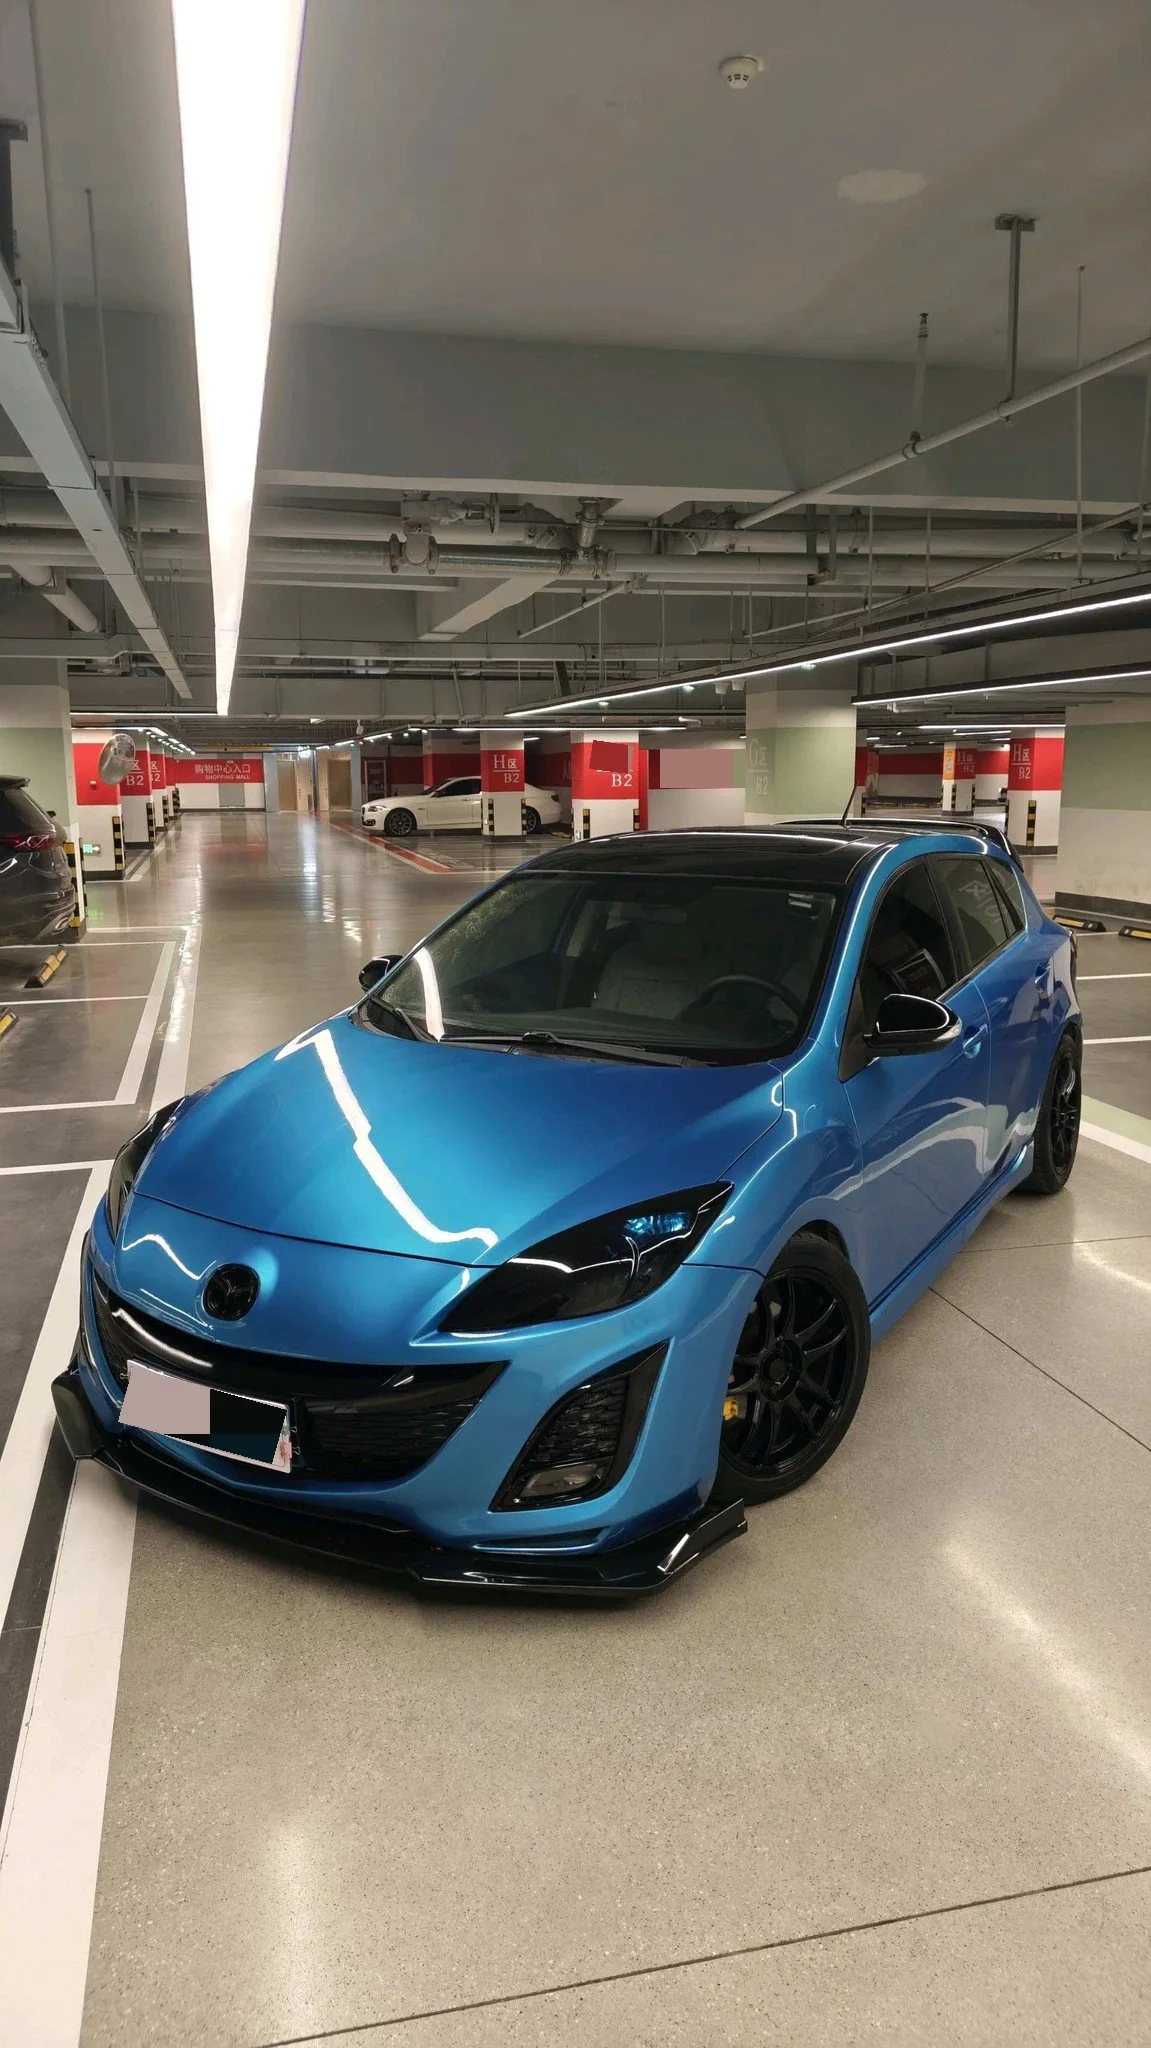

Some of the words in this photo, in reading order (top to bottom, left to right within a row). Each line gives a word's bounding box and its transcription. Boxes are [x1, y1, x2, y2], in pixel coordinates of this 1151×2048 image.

[1012, 744, 1030, 762] H区
[493, 754, 518, 769] H区
[194, 763, 251, 775] 购物中心入口
[1018, 767, 1031, 779] B2
[126, 775, 144, 786] B2
[504, 773, 520, 783] B2
[611, 773, 633, 787] B2
